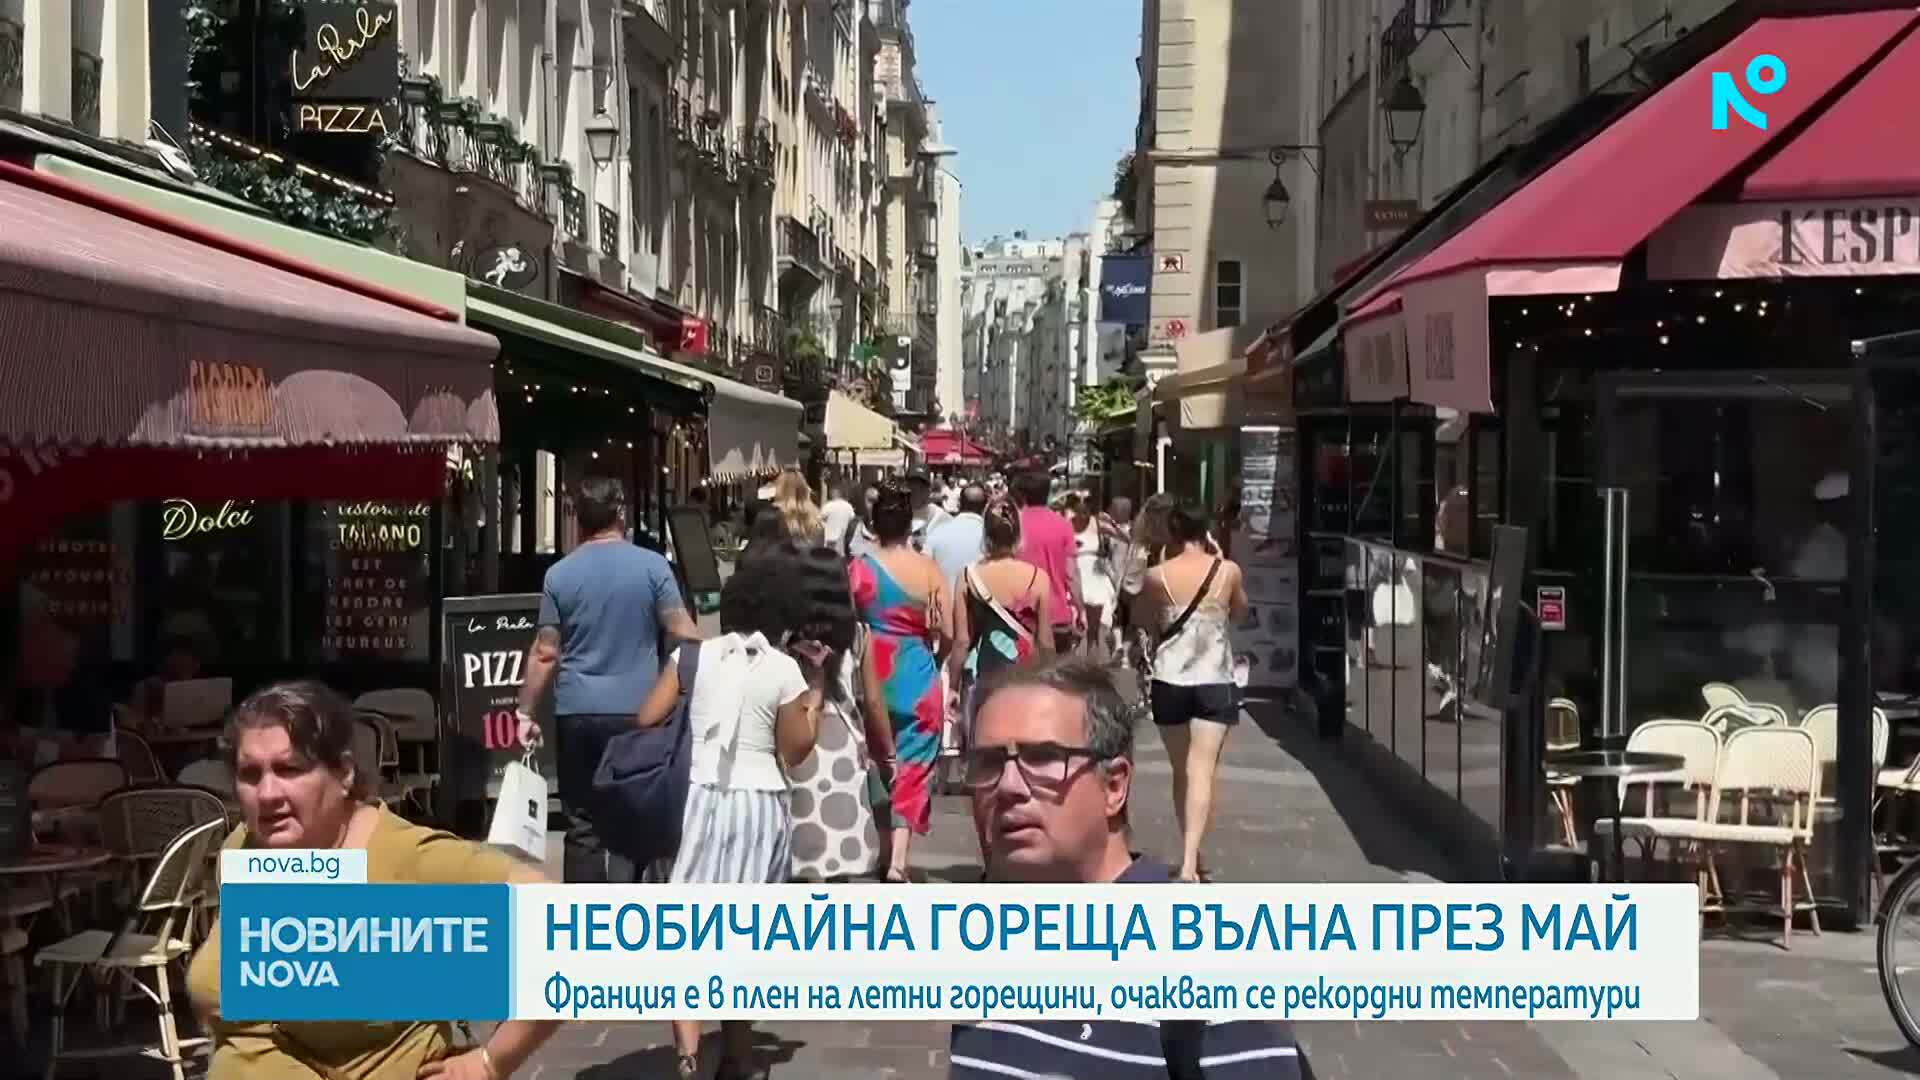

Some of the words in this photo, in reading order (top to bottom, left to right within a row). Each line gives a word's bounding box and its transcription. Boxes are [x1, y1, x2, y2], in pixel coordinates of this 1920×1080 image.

[292, 49, 332, 90] La
[301, 105, 388, 133] PIZZA
[1778, 207, 1920, 264] L'ESP
[163, 499, 255, 540] Dolci
[463, 650, 526, 688] PIZZ
